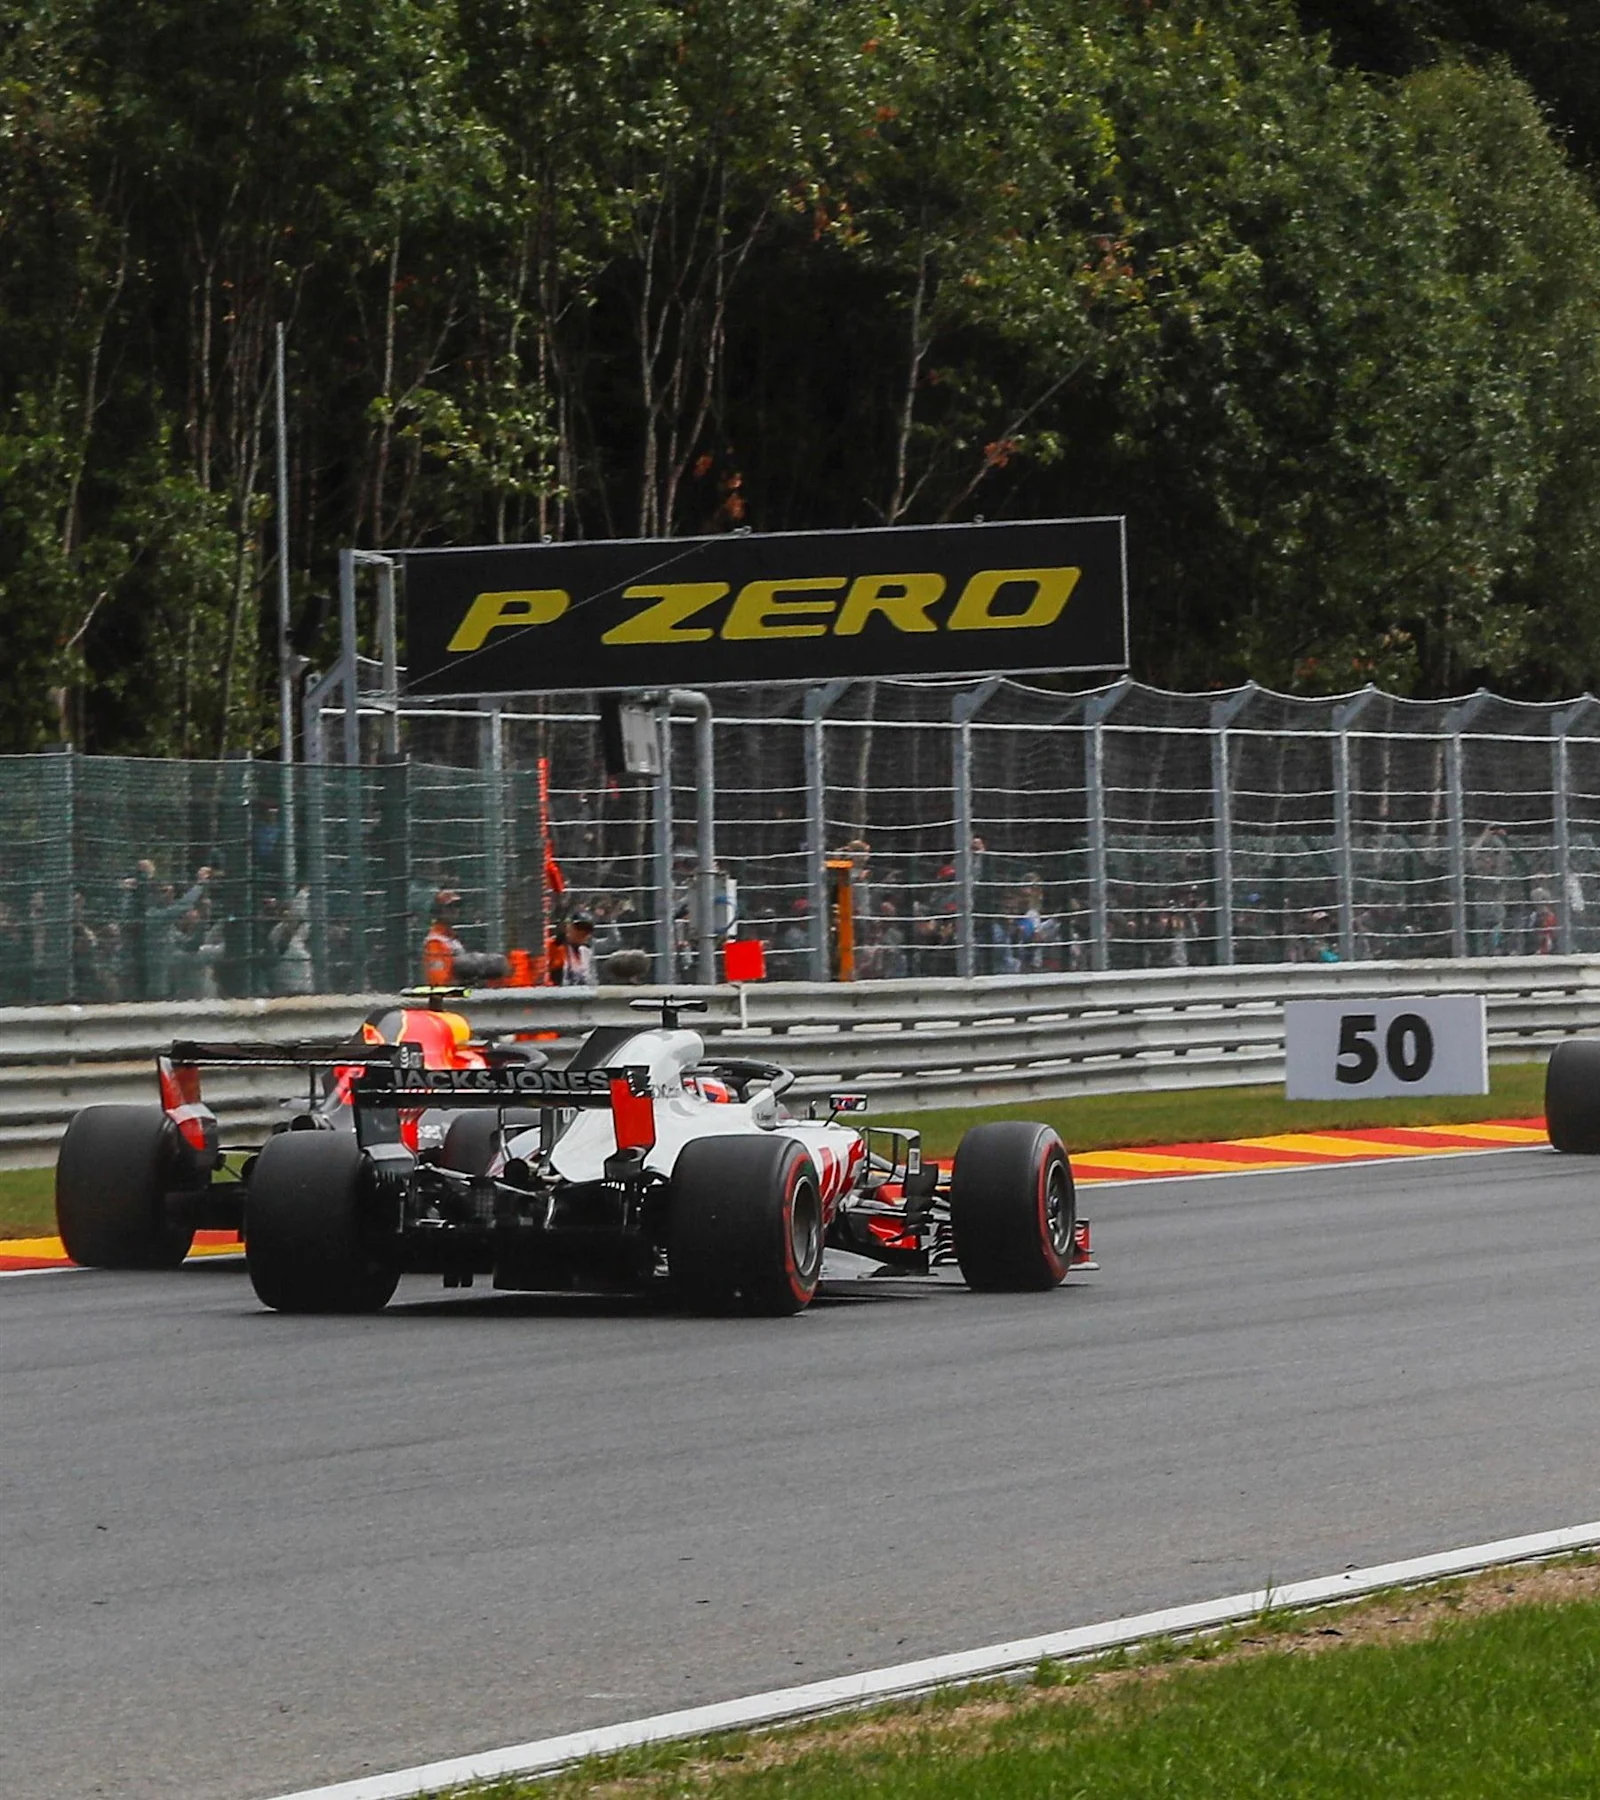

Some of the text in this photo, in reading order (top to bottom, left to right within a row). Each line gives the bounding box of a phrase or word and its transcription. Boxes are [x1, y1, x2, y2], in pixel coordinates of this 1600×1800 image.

[446, 566, 1082, 652] P ZERO
[1335, 1013, 1433, 1084] 50
